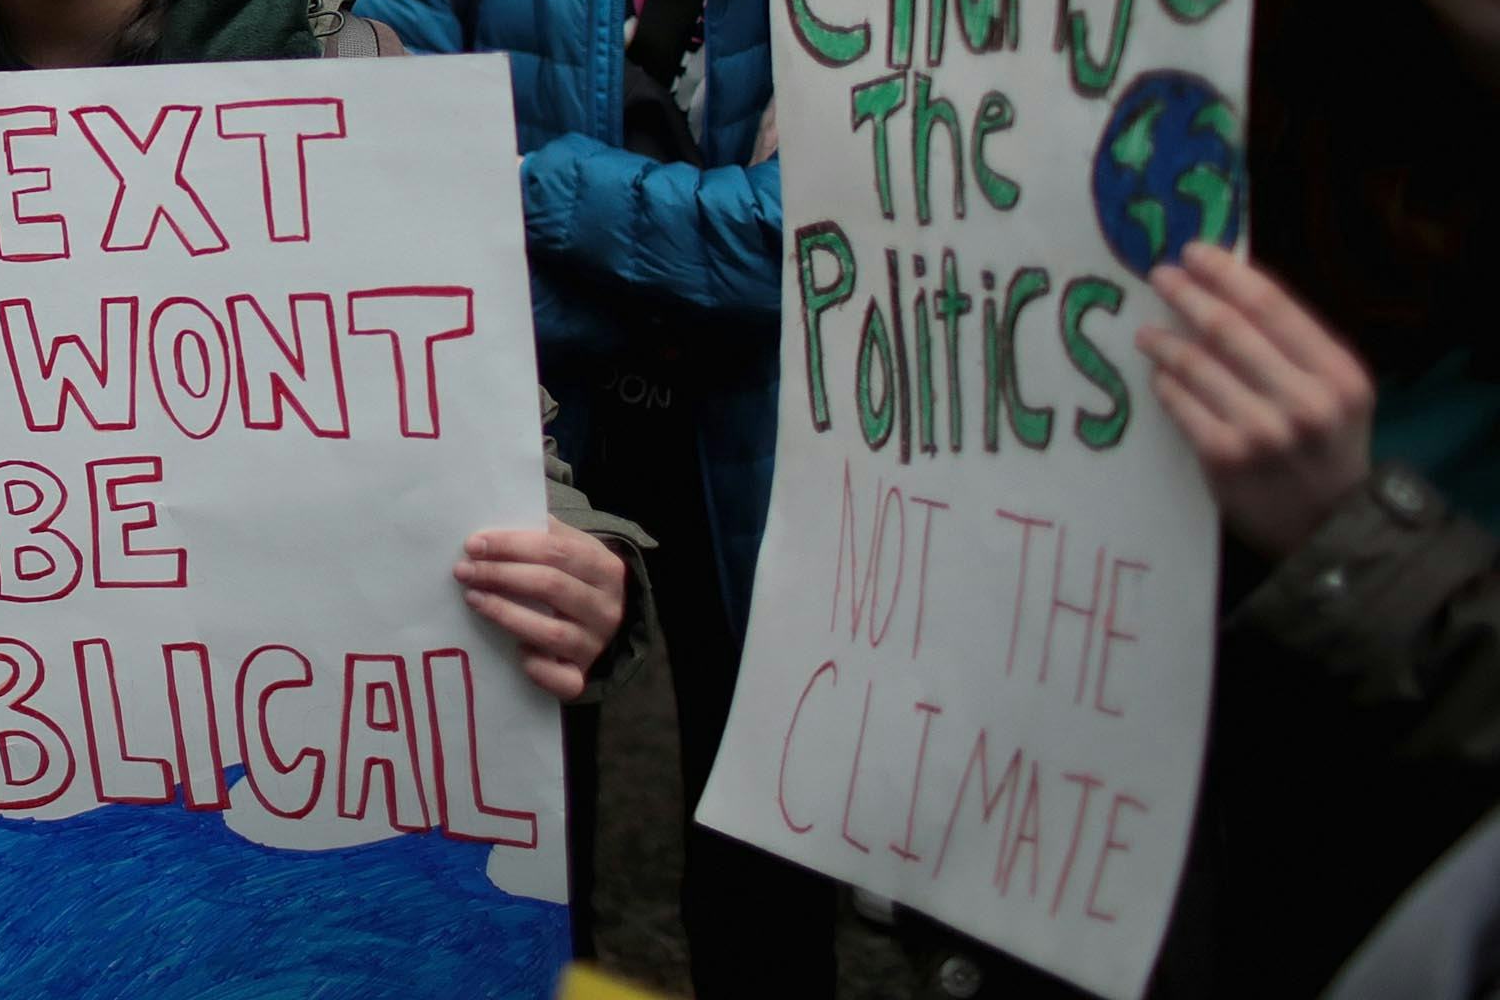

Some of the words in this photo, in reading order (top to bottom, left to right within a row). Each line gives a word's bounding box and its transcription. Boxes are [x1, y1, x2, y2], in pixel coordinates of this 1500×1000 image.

[850, 70, 1021, 226] The
[793, 220, 1132, 465] Politics
[830, 457, 950, 660] NOT
[995, 508, 1152, 718] THE
[778, 659, 1149, 923] CLIMATE
